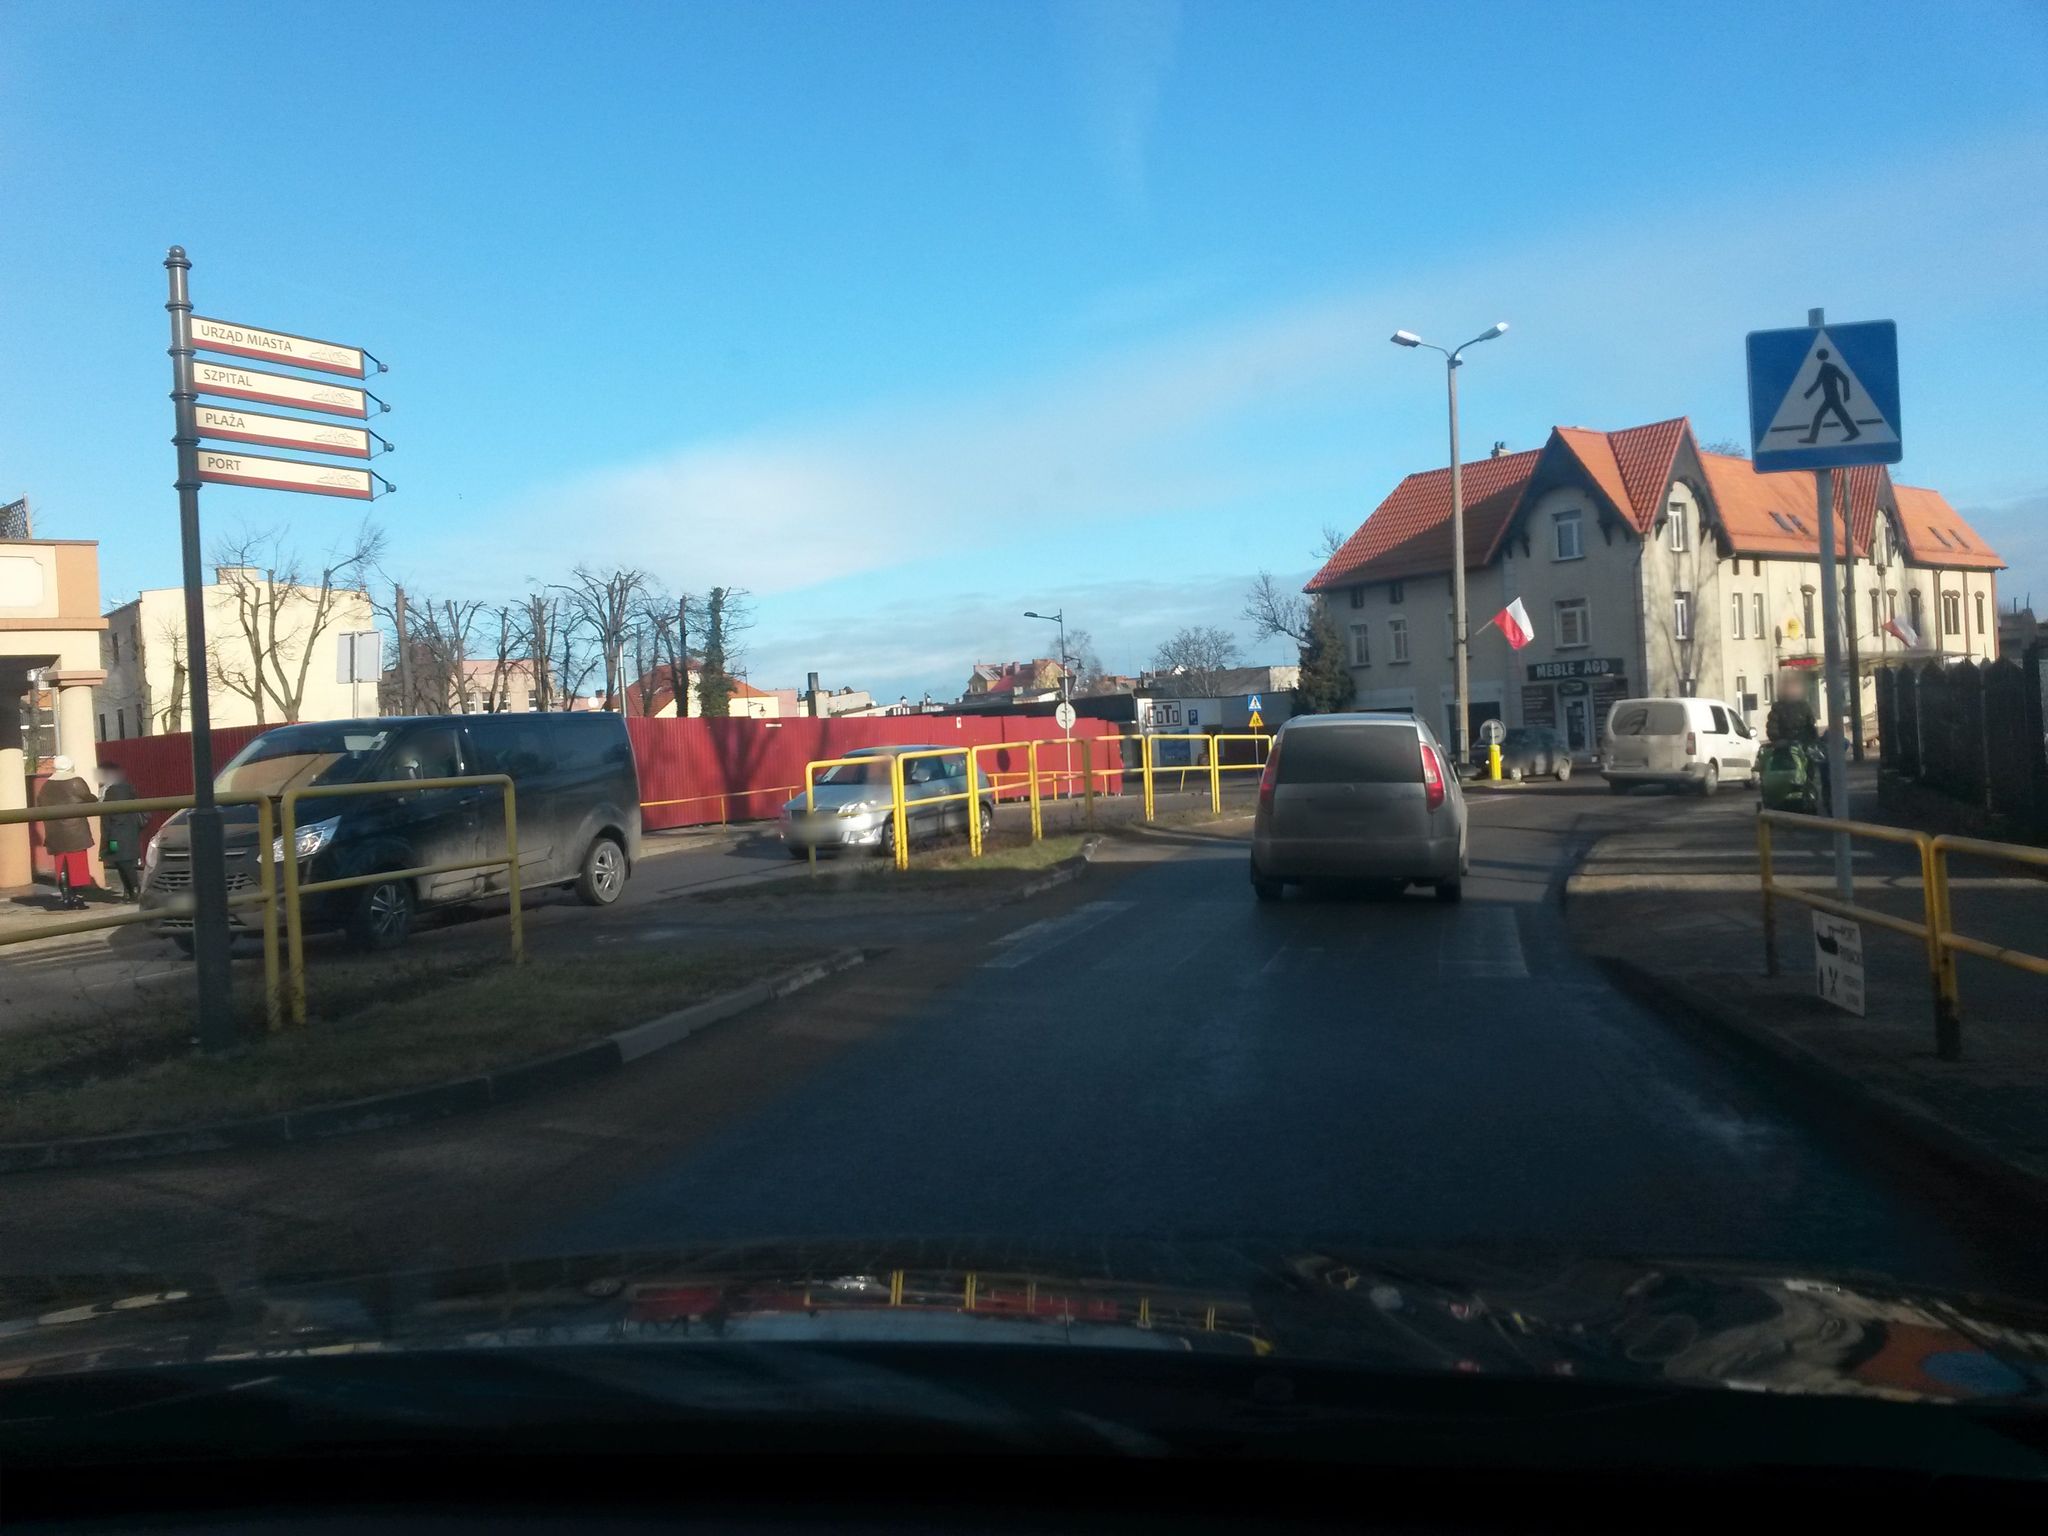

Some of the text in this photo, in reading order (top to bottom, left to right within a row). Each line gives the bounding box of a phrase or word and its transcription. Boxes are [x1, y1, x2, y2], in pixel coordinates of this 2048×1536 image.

[201, 324, 292, 352] URZĄD MIASTA
[203, 368, 253, 387] SZPITAL
[205, 412, 245, 428] PLAŻA
[207, 456, 241, 471] PORT
[1536, 659, 1610, 678] MEBLE AGD
